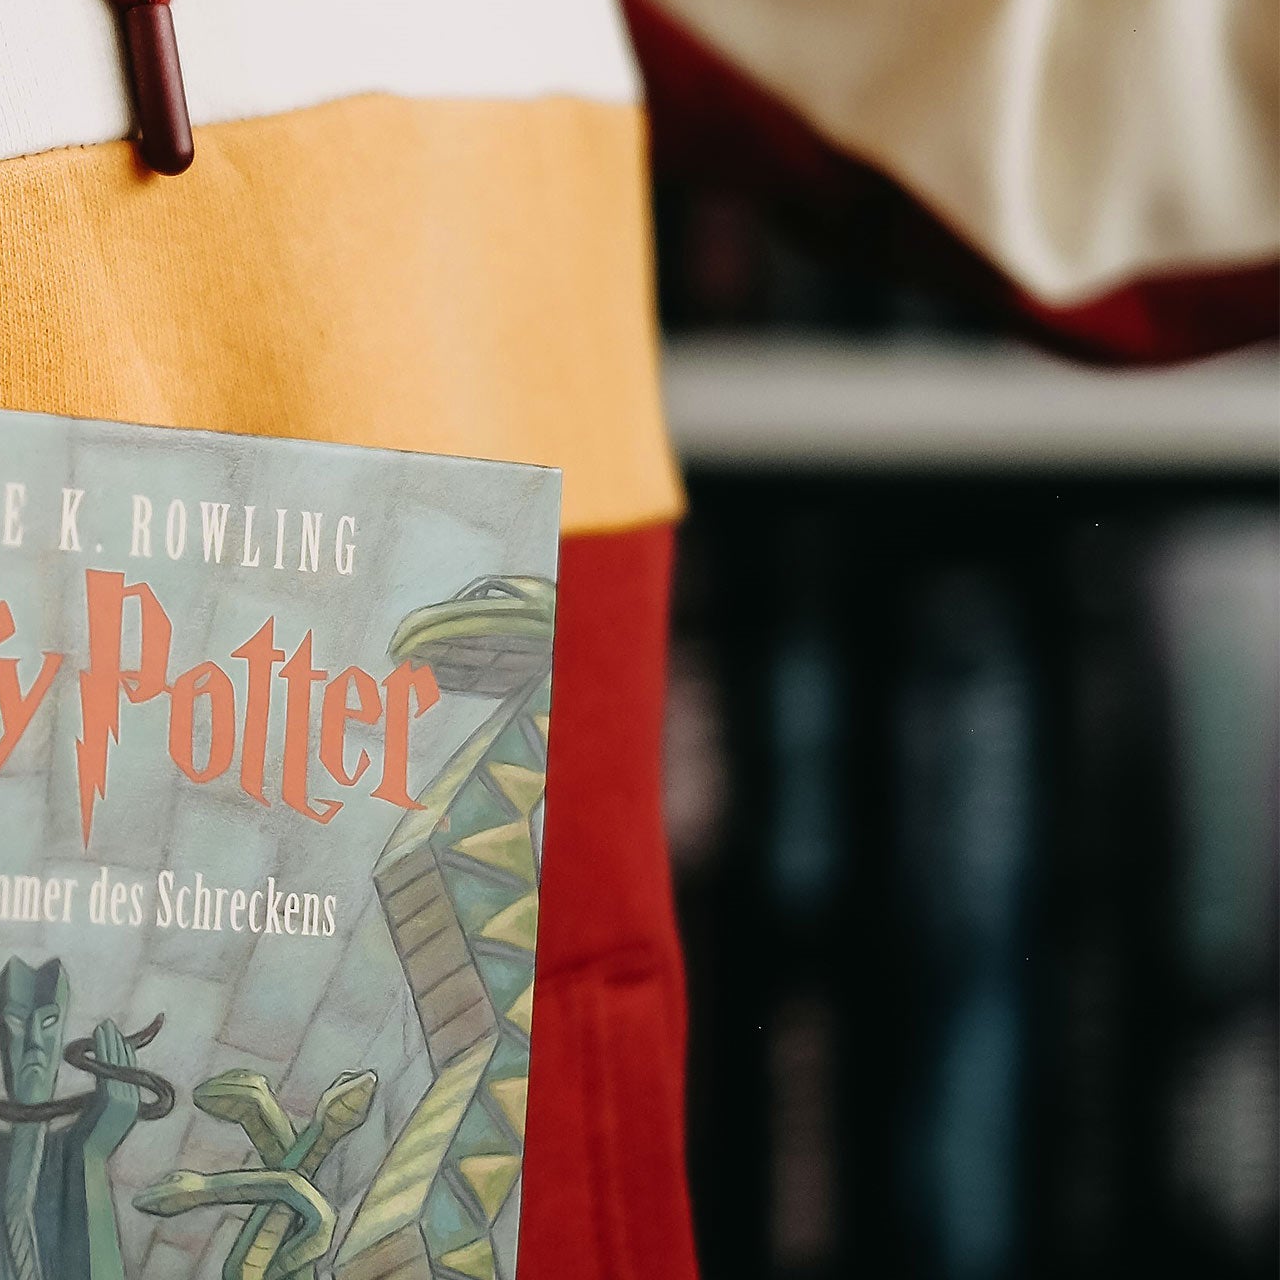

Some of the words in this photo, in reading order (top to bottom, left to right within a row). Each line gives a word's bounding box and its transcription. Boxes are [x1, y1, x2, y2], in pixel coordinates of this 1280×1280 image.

[58, 487, 106, 554] K.
[129, 494, 357, 576] ROWLING
[75, 568, 443, 853] Potter
[87, 865, 144, 927] des
[155, 868, 338, 938] Schreckens
